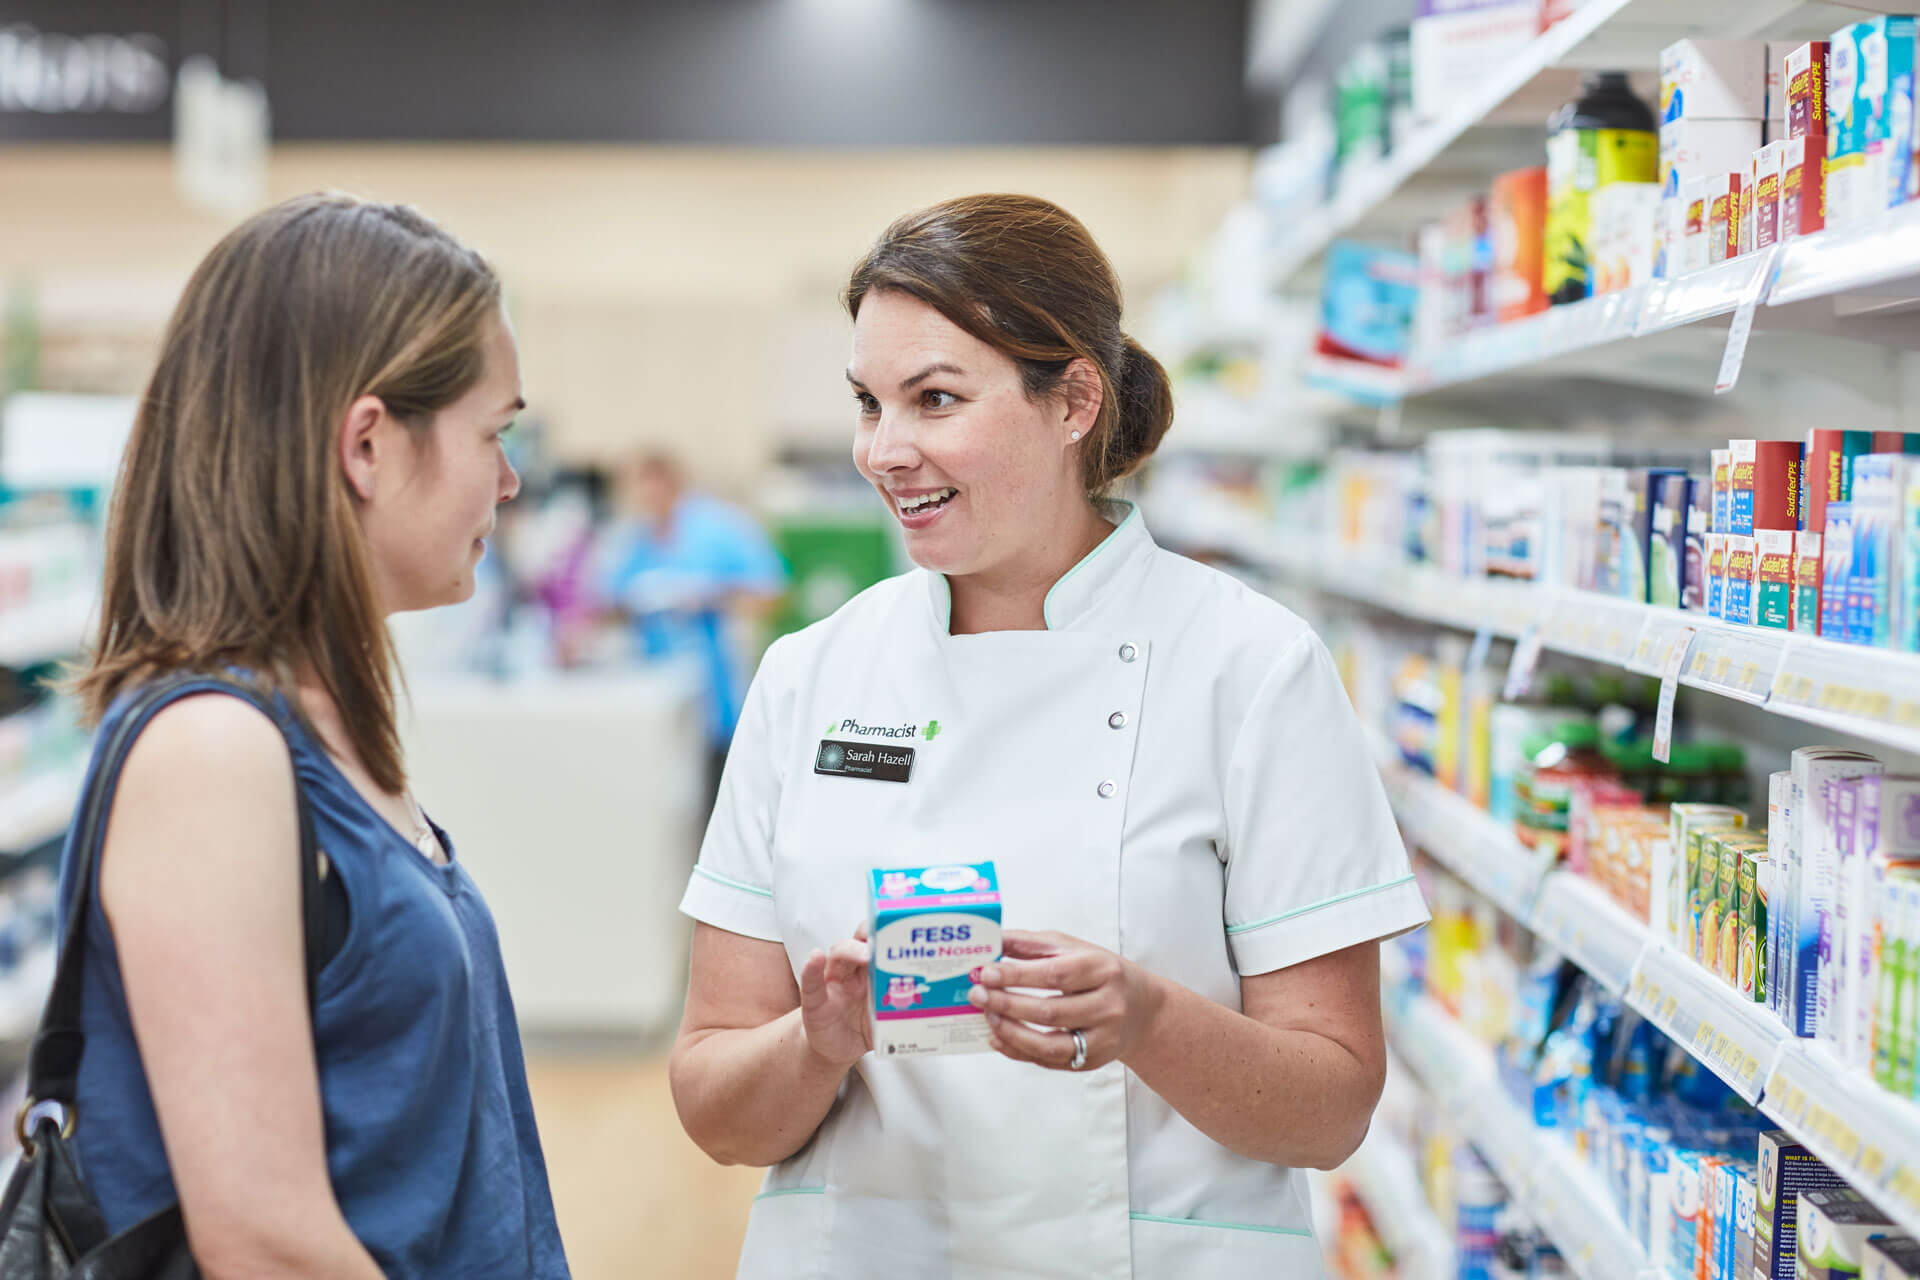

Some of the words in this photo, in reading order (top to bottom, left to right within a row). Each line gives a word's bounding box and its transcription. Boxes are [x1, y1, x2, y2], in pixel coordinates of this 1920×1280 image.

[1811, 78, 1822, 120] Sudafed
[1728, 206, 1738, 246] Sudafed
[1788, 460, 1797, 475] PE
[1786, 477, 1797, 518] Sudafed
[840, 719, 917, 738] Pharmacist
[846, 749, 875, 763] Sarah
[877, 752, 911, 766] Hazell
[911, 924, 971, 943] FESS
